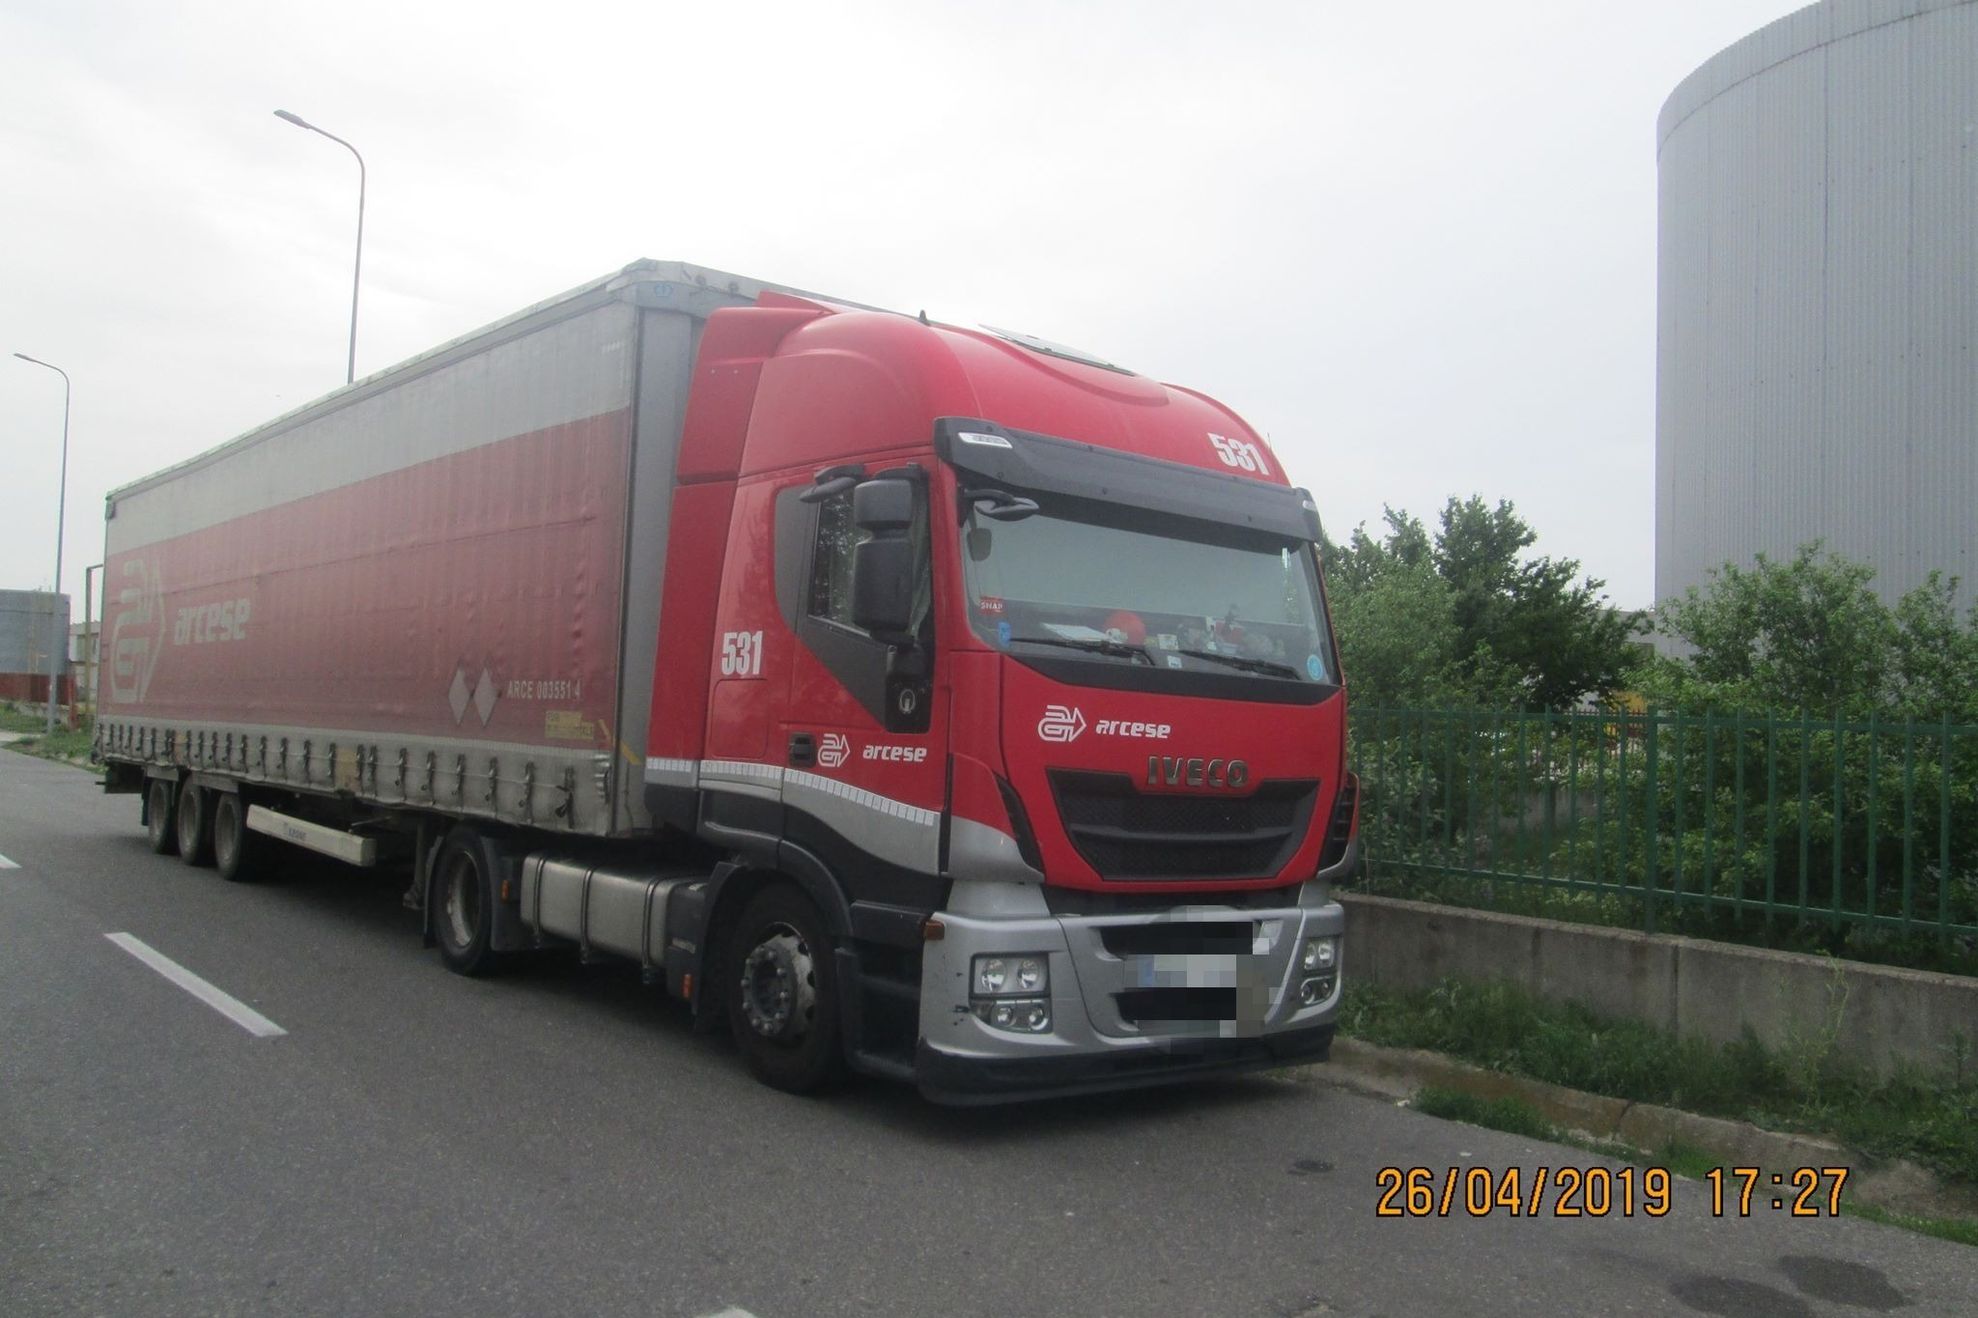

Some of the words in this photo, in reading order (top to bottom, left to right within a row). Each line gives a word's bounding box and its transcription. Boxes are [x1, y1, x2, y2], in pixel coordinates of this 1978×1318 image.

[1208, 432, 1269, 476] 531
[174, 599, 250, 645] arcese
[721, 630, 764, 676] 531
[507, 680, 533, 699] ARCE
[1095, 719, 1172, 739] arcese
[863, 743, 928, 762] arcese
[1147, 755, 1249, 788] IVECO
